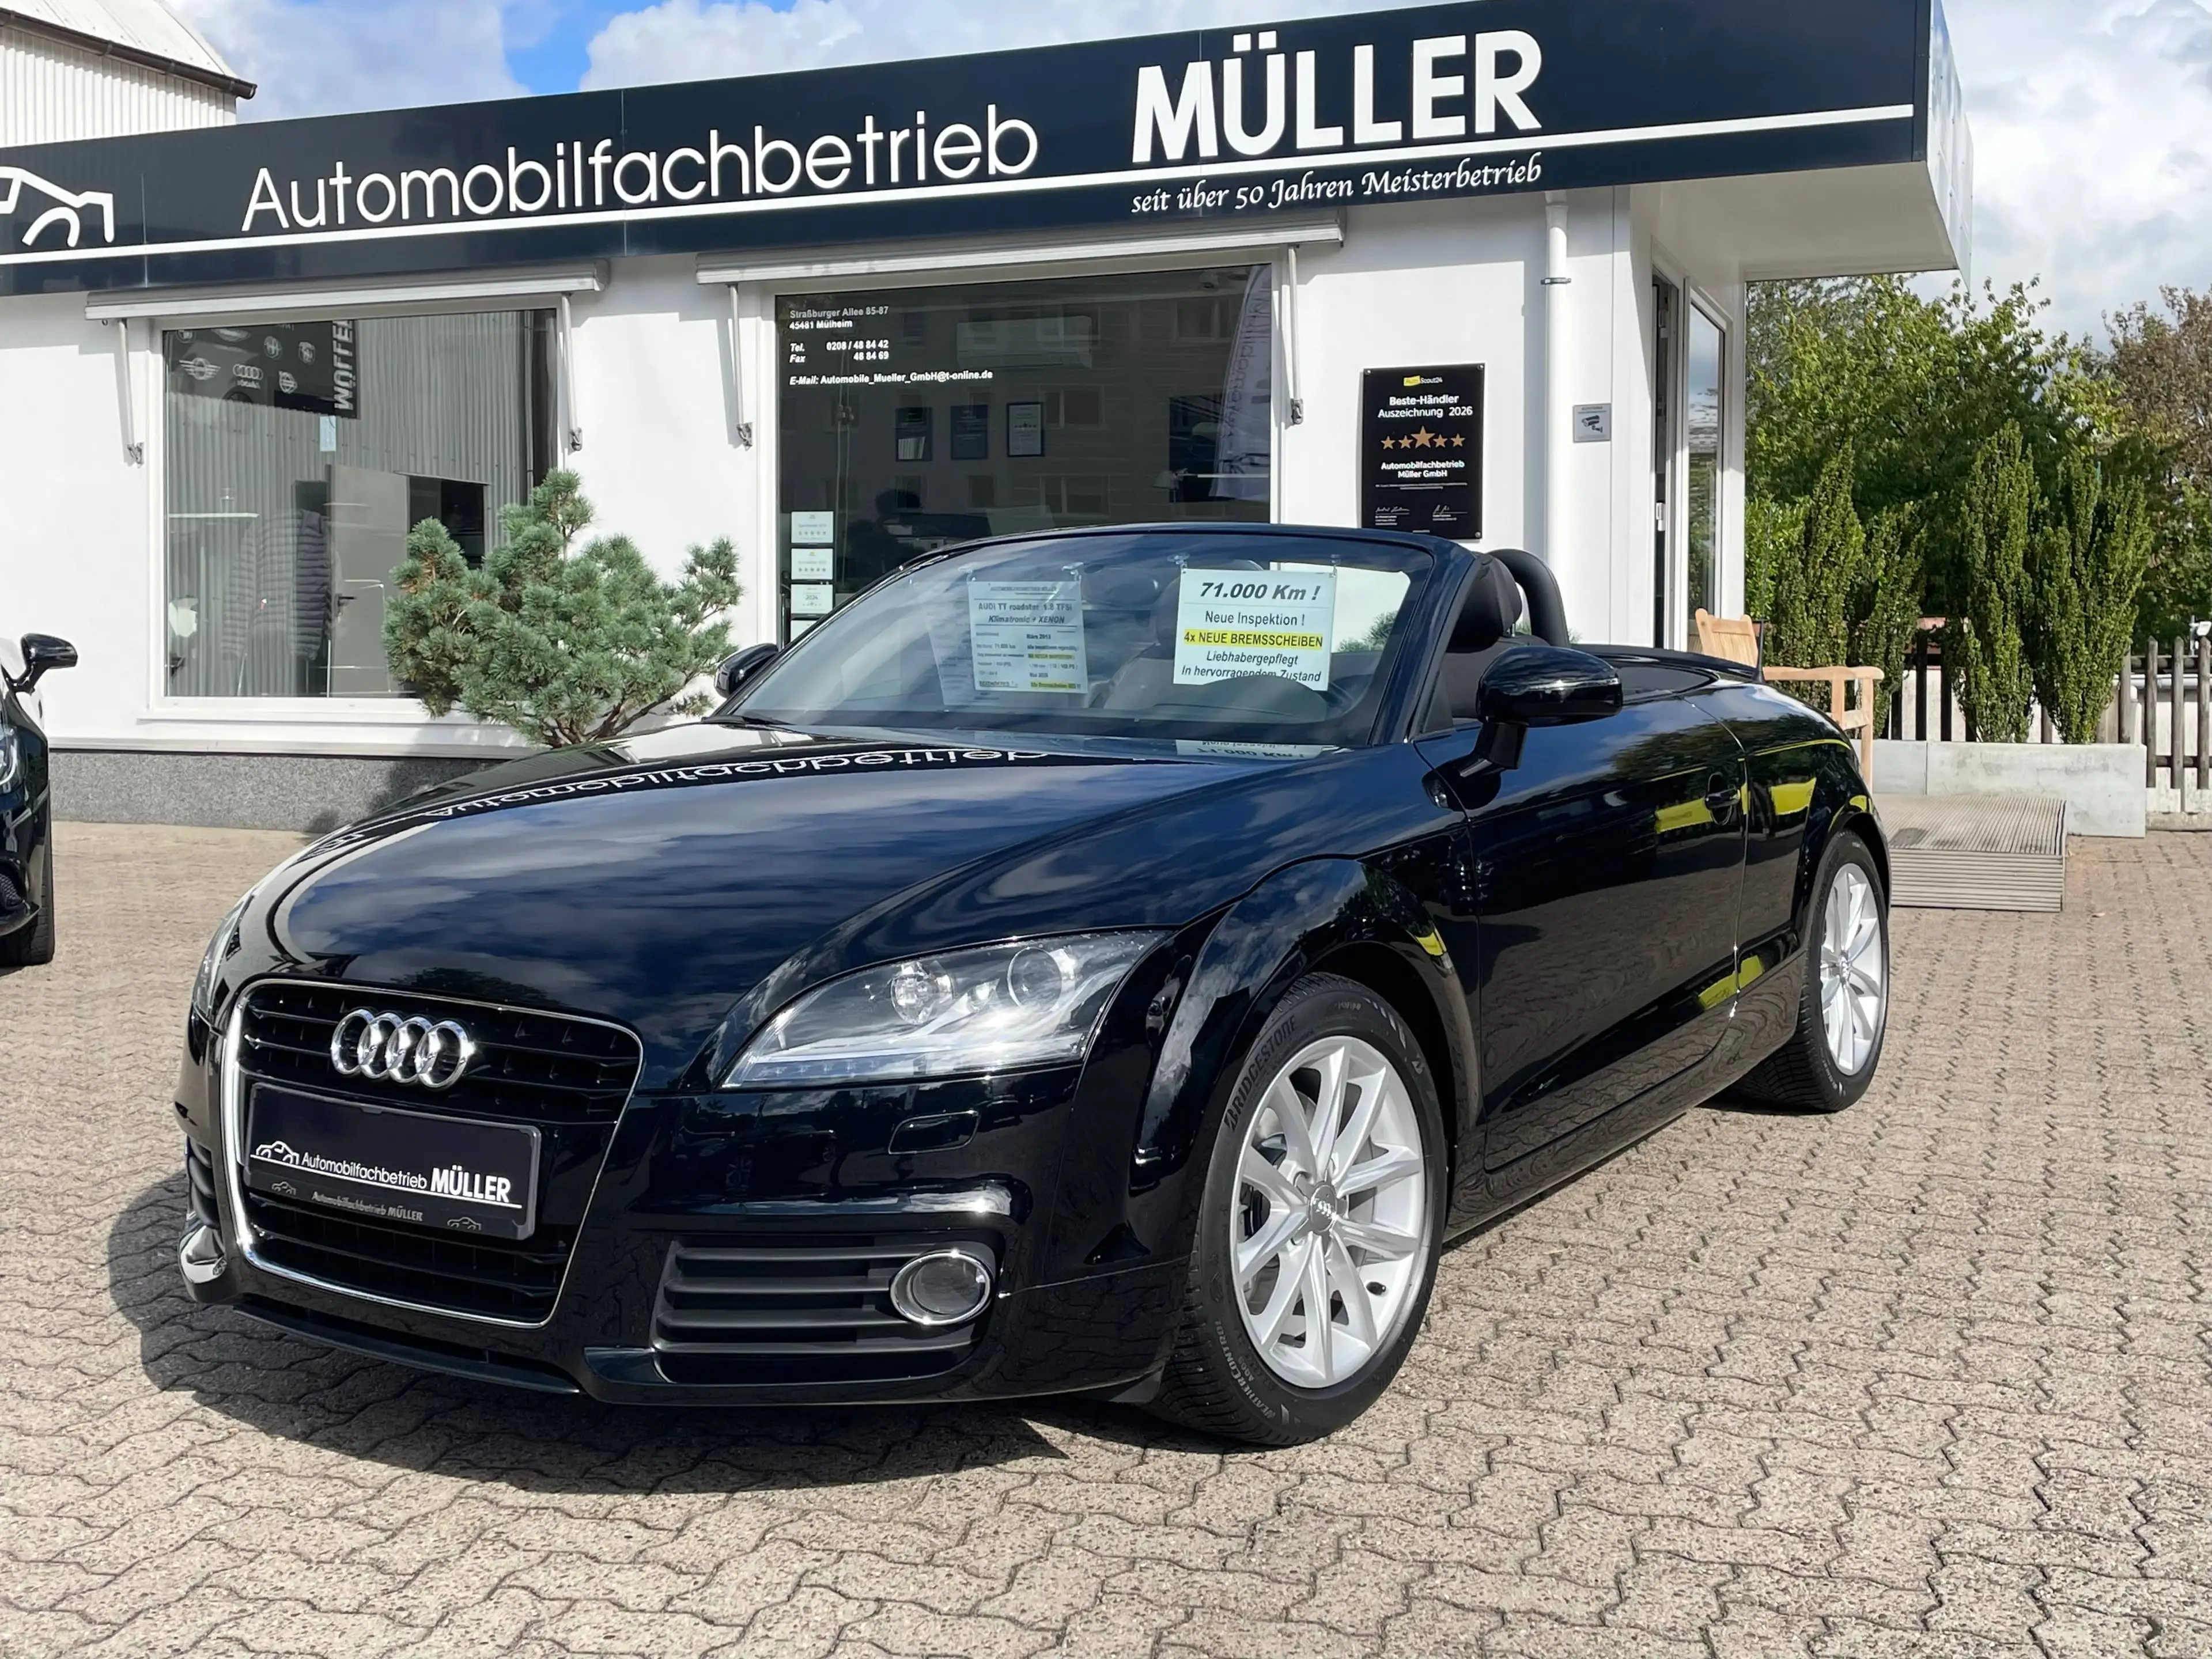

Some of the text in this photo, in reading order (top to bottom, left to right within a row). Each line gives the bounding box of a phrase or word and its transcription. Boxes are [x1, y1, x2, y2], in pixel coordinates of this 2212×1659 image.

[241, 29, 1542, 232] Automobilfachbetrieb MÜLLER
[1131, 151, 1542, 213] seit über 50 Jahren Meisterbetrieb
[790, 306, 888, 319] Straßburger Allee 85-87
[789, 319, 853, 329] 45481 Mülheim
[790, 343, 805, 352] Tel.
[826, 342, 846, 350] 0208
[853, 341, 864, 350] 48
[866, 340, 876, 349] 84
[878, 340, 888, 349] 42
[789, 351, 889, 363] Fax 48 84 69
[789, 376, 819, 385] E-Mail:
[1389, 394, 1459, 406] Beste-Händler
[1378, 406, 1473, 418] Auszeichnung 2026
[1381, 460, 1465, 470] Automobilfachbetrieb
[1398, 469, 1448, 478] Müller GmbH
[1200, 582, 1321, 600] 71.000 Km !
[978, 603, 996, 611] AUDI
[988, 615, 1030, 623] Klimatronic
[1038, 615, 1065, 624] XENON
[1205, 611, 1234, 623] Neue
[1238, 612, 1297, 627] Inspektion
[1184, 632, 1323, 647] 4x NEUE BREMSSCHEIBEN
[1206, 650, 1298, 668] Liebhabergepflegt
[1182, 665, 1191, 676] In
[1280, 669, 1322, 683] Zustand
[1223, 1014, 1296, 1132] BRIDGESTONE
[301, 1152, 512, 1203] Automobilfachbetrieb MÜLLER
[387, 1205, 424, 1222] MÜLLER
